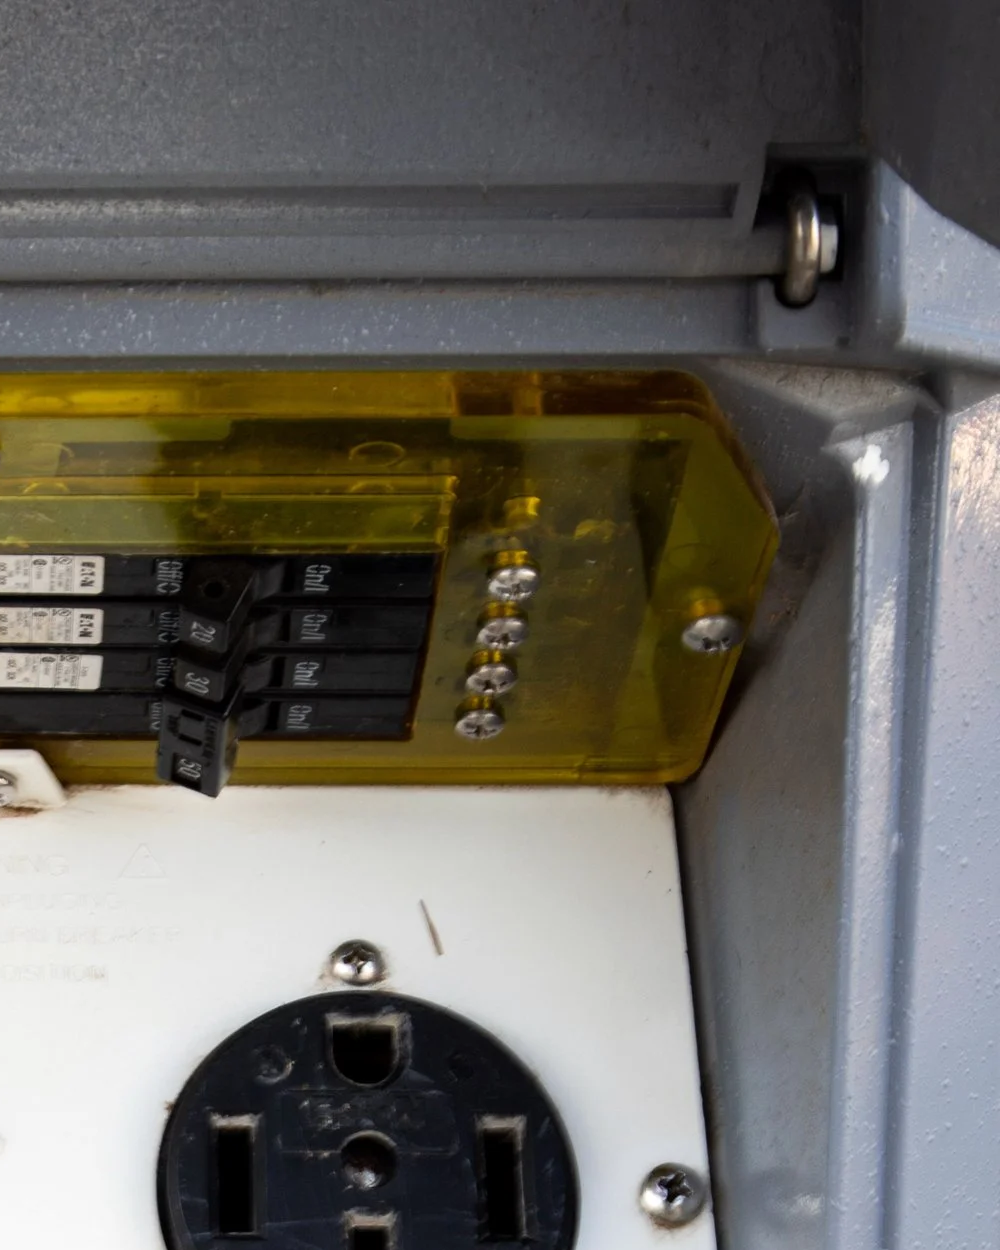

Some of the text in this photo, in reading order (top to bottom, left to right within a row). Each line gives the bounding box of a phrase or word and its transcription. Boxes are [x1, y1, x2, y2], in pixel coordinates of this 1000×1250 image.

[190, 621, 216, 643] 20
[185, 672, 210, 694] 30
[178, 758, 202, 780] 50
